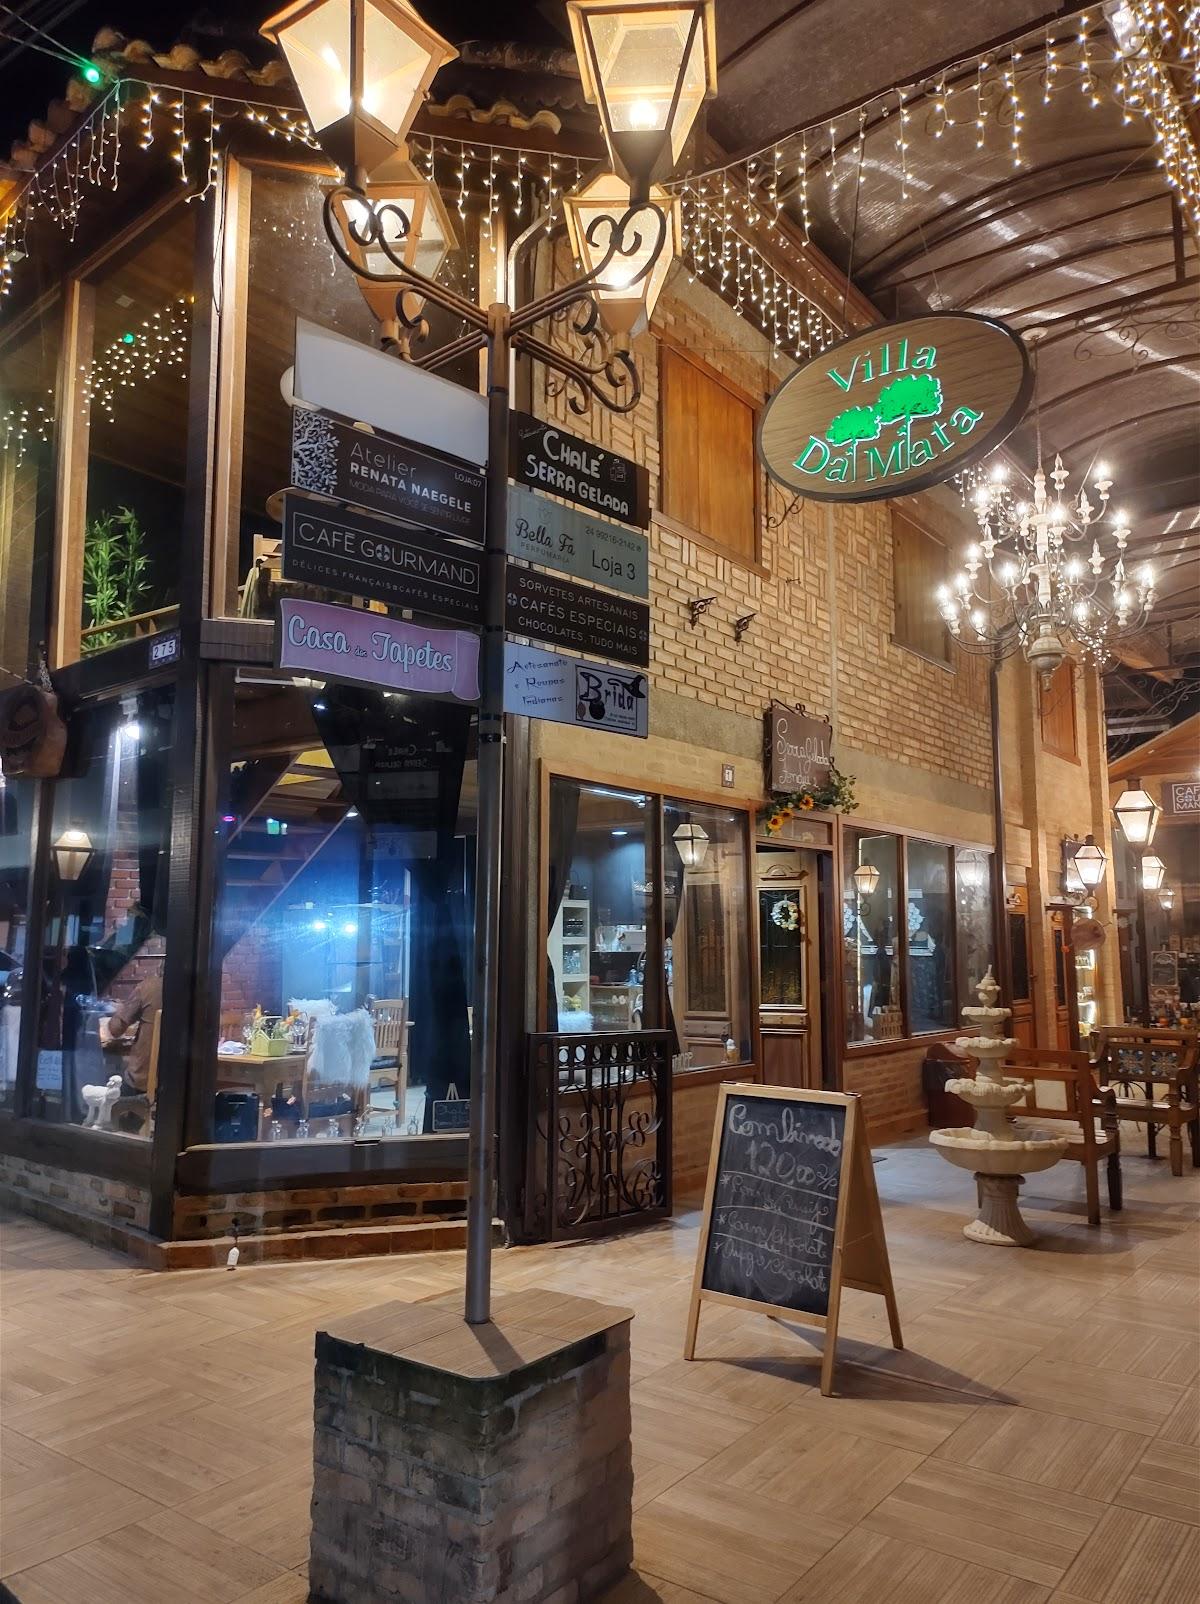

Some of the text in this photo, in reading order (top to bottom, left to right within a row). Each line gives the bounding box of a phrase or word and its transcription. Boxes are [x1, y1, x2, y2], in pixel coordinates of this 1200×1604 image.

[827, 338, 937, 392] Villa
[350, 442, 417, 478] Atelier
[350, 462, 471, 513] RENATA NAEGELE
[515, 518, 553, 548] Bella
[292, 559, 338, 577] DÉLICES
[299, 522, 475, 585] CAFÉ GOURMAND
[592, 550, 636, 580] Loja 3
[519, 577, 639, 621] SORVETES ARTESANAIS
[520, 596, 638, 639] CAFÉS ESPECIAIS
[154, 641, 174, 658] 275
[289, 615, 350, 654] Casa
[371, 632, 453, 673] Tapetes
[590, 634, 614, 649] TUDO
[616, 642, 638, 656] MAIS
[1176, 786, 1200, 796] CAF
[1176, 802, 1200, 810] MAN
